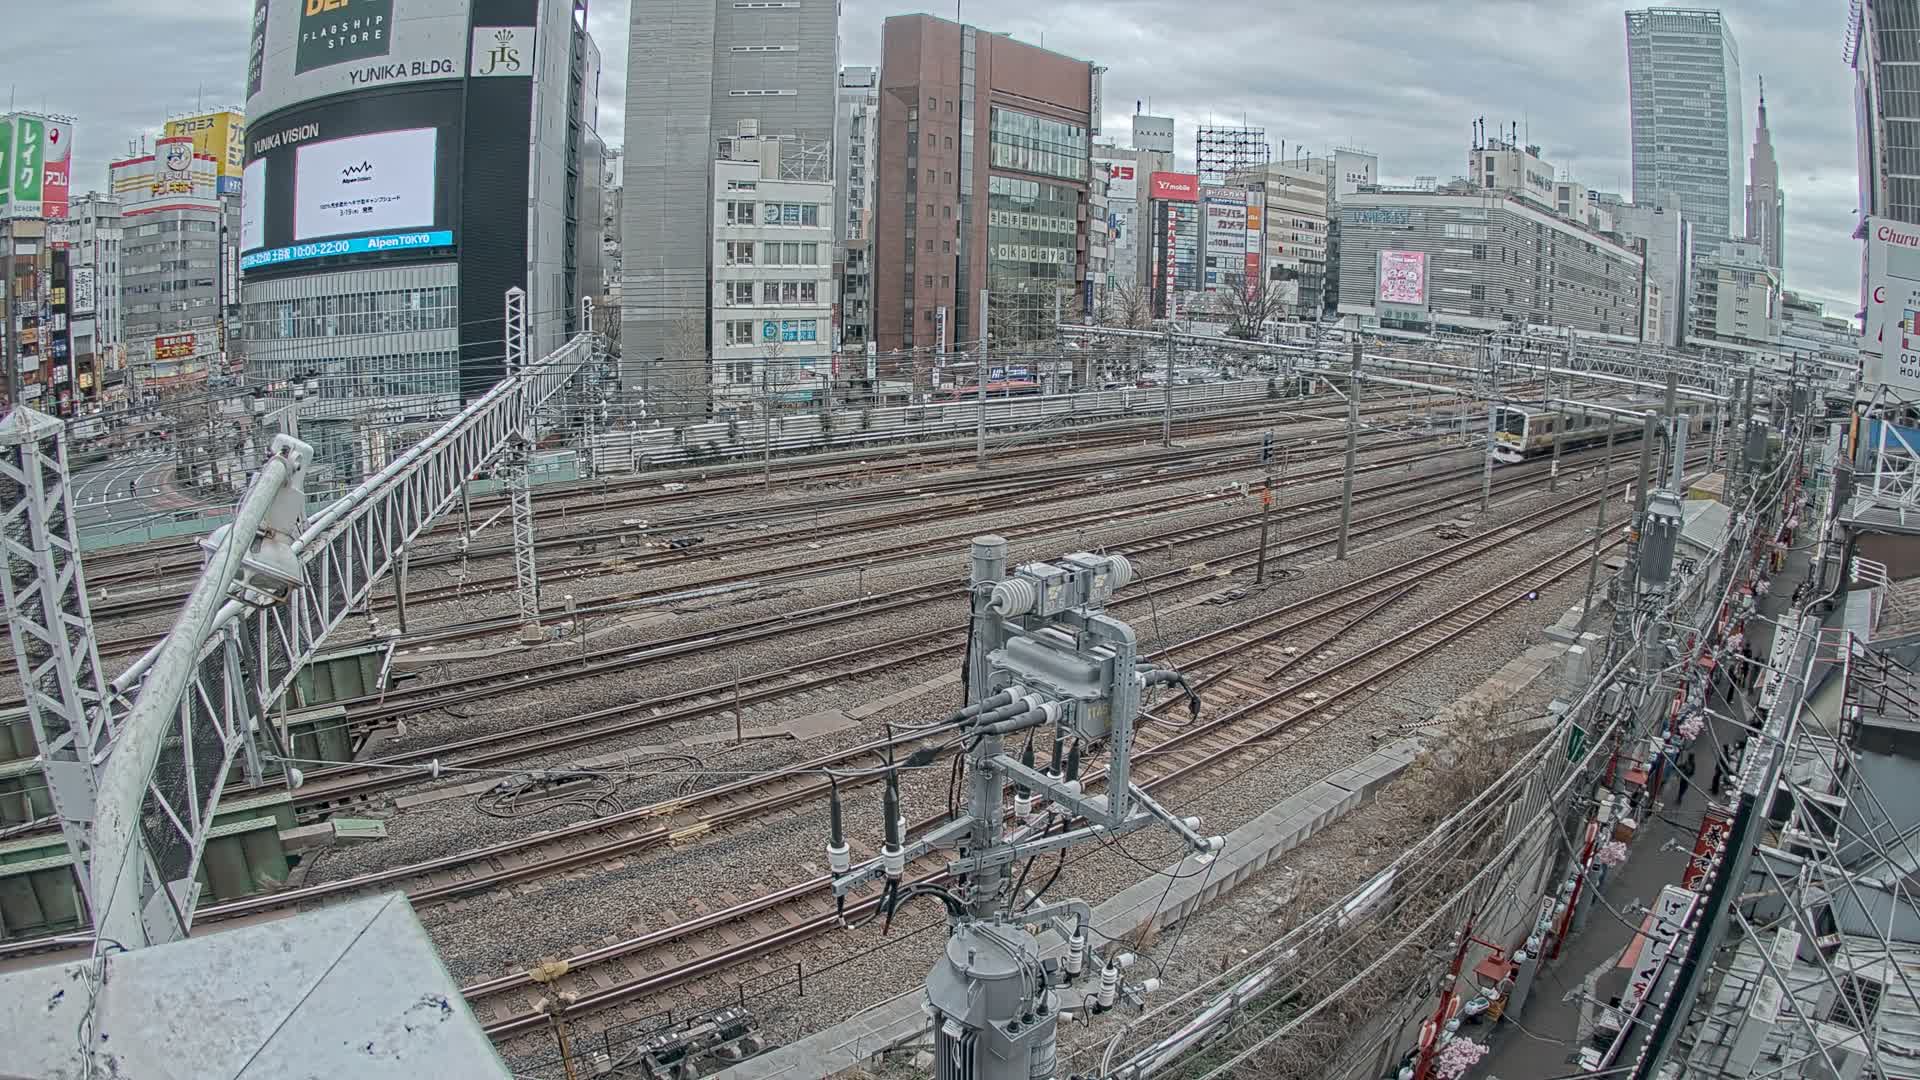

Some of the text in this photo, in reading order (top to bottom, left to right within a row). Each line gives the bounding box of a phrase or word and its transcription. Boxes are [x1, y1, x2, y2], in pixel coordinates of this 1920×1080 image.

[303, 15, 383, 42] FLAGSHIP
[328, 29, 382, 49] STORE
[349, 59, 455, 85] YUNIKA BLDG.
[175, 117, 215, 136] プロミス
[253, 122, 319, 156] YUNIKA VISION
[20, 121, 37, 190] レイク
[44, 170, 68, 187] アコム
[292, 239, 350, 258] 10:00-22:00
[367, 233, 430, 250] Alpen TOKYO
